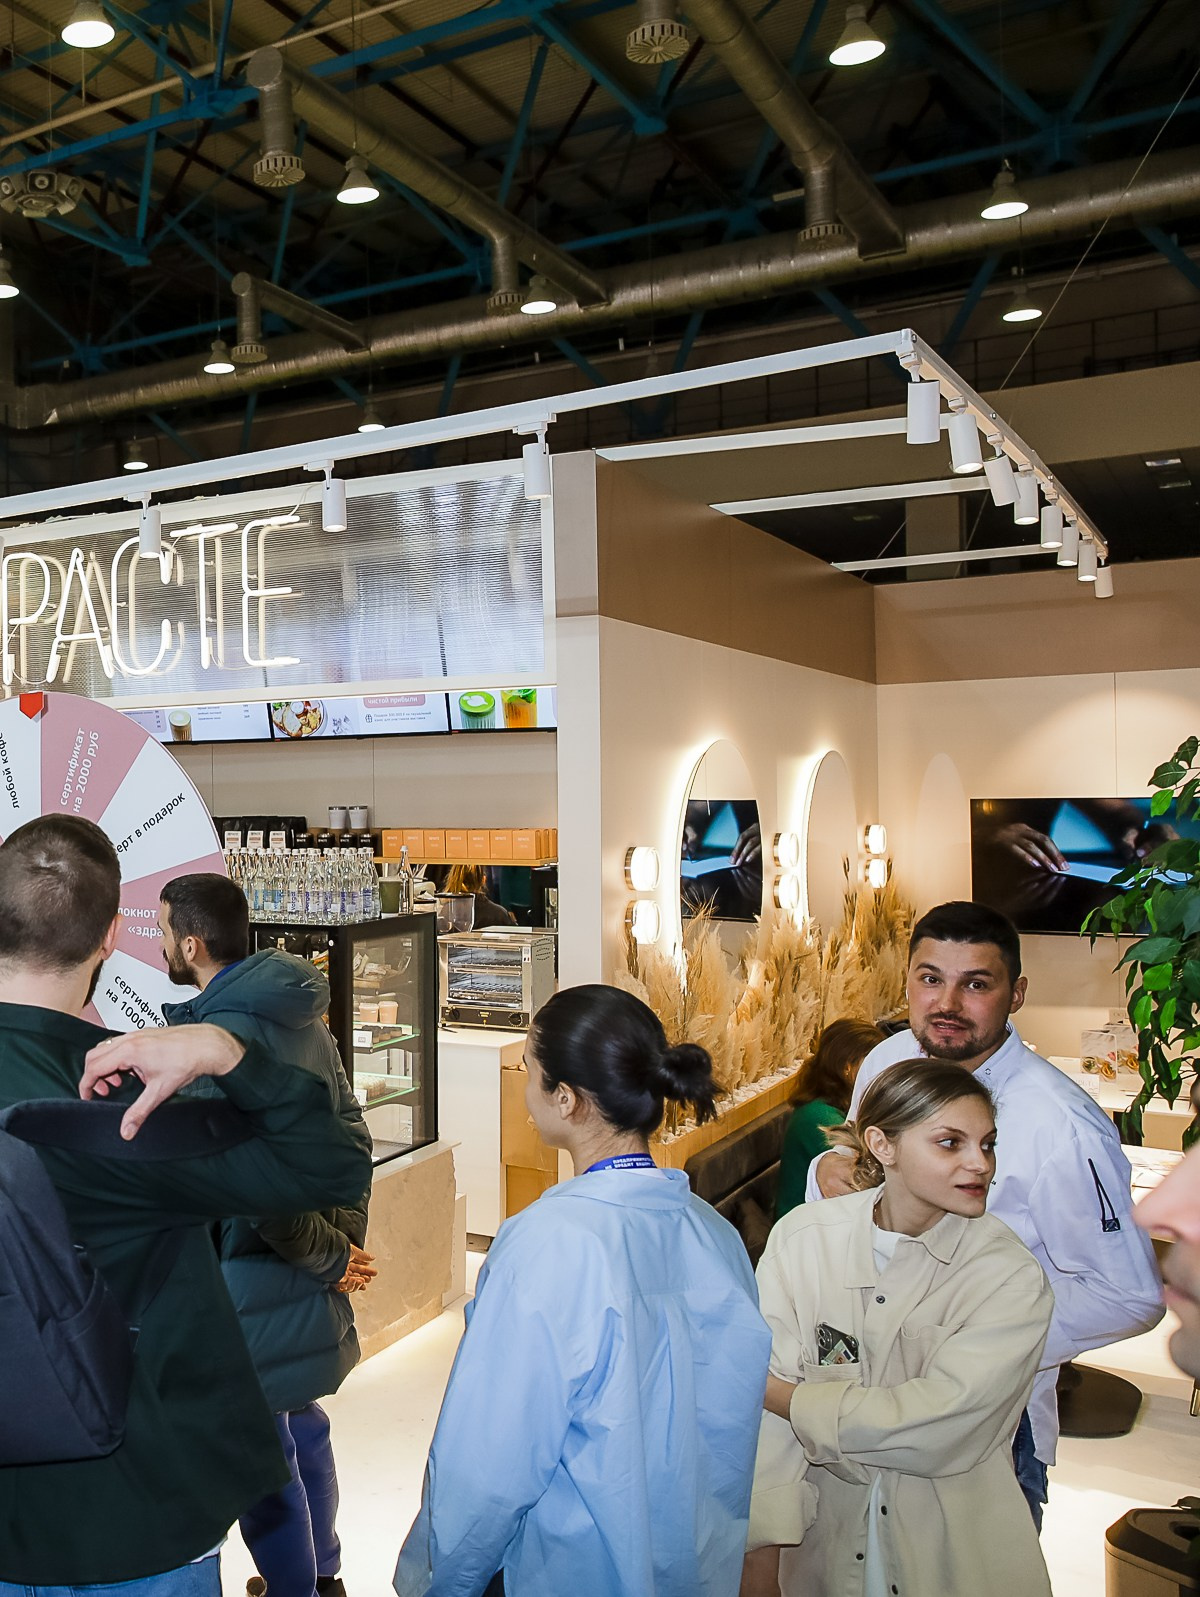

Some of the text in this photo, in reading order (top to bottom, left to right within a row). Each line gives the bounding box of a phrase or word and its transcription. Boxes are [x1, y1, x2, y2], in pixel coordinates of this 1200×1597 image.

[2, 767, 20, 809] любой
[60, 727, 85, 806] сертификат
[72, 731, 99, 813] на 2000 руб
[116, 792, 186, 856] ерт в подарок
[117, 907, 157, 918] локнот
[127, 926, 164, 940] «здра
[105, 988, 146, 1030] на 1000
[114, 975, 168, 1028] сертифика
